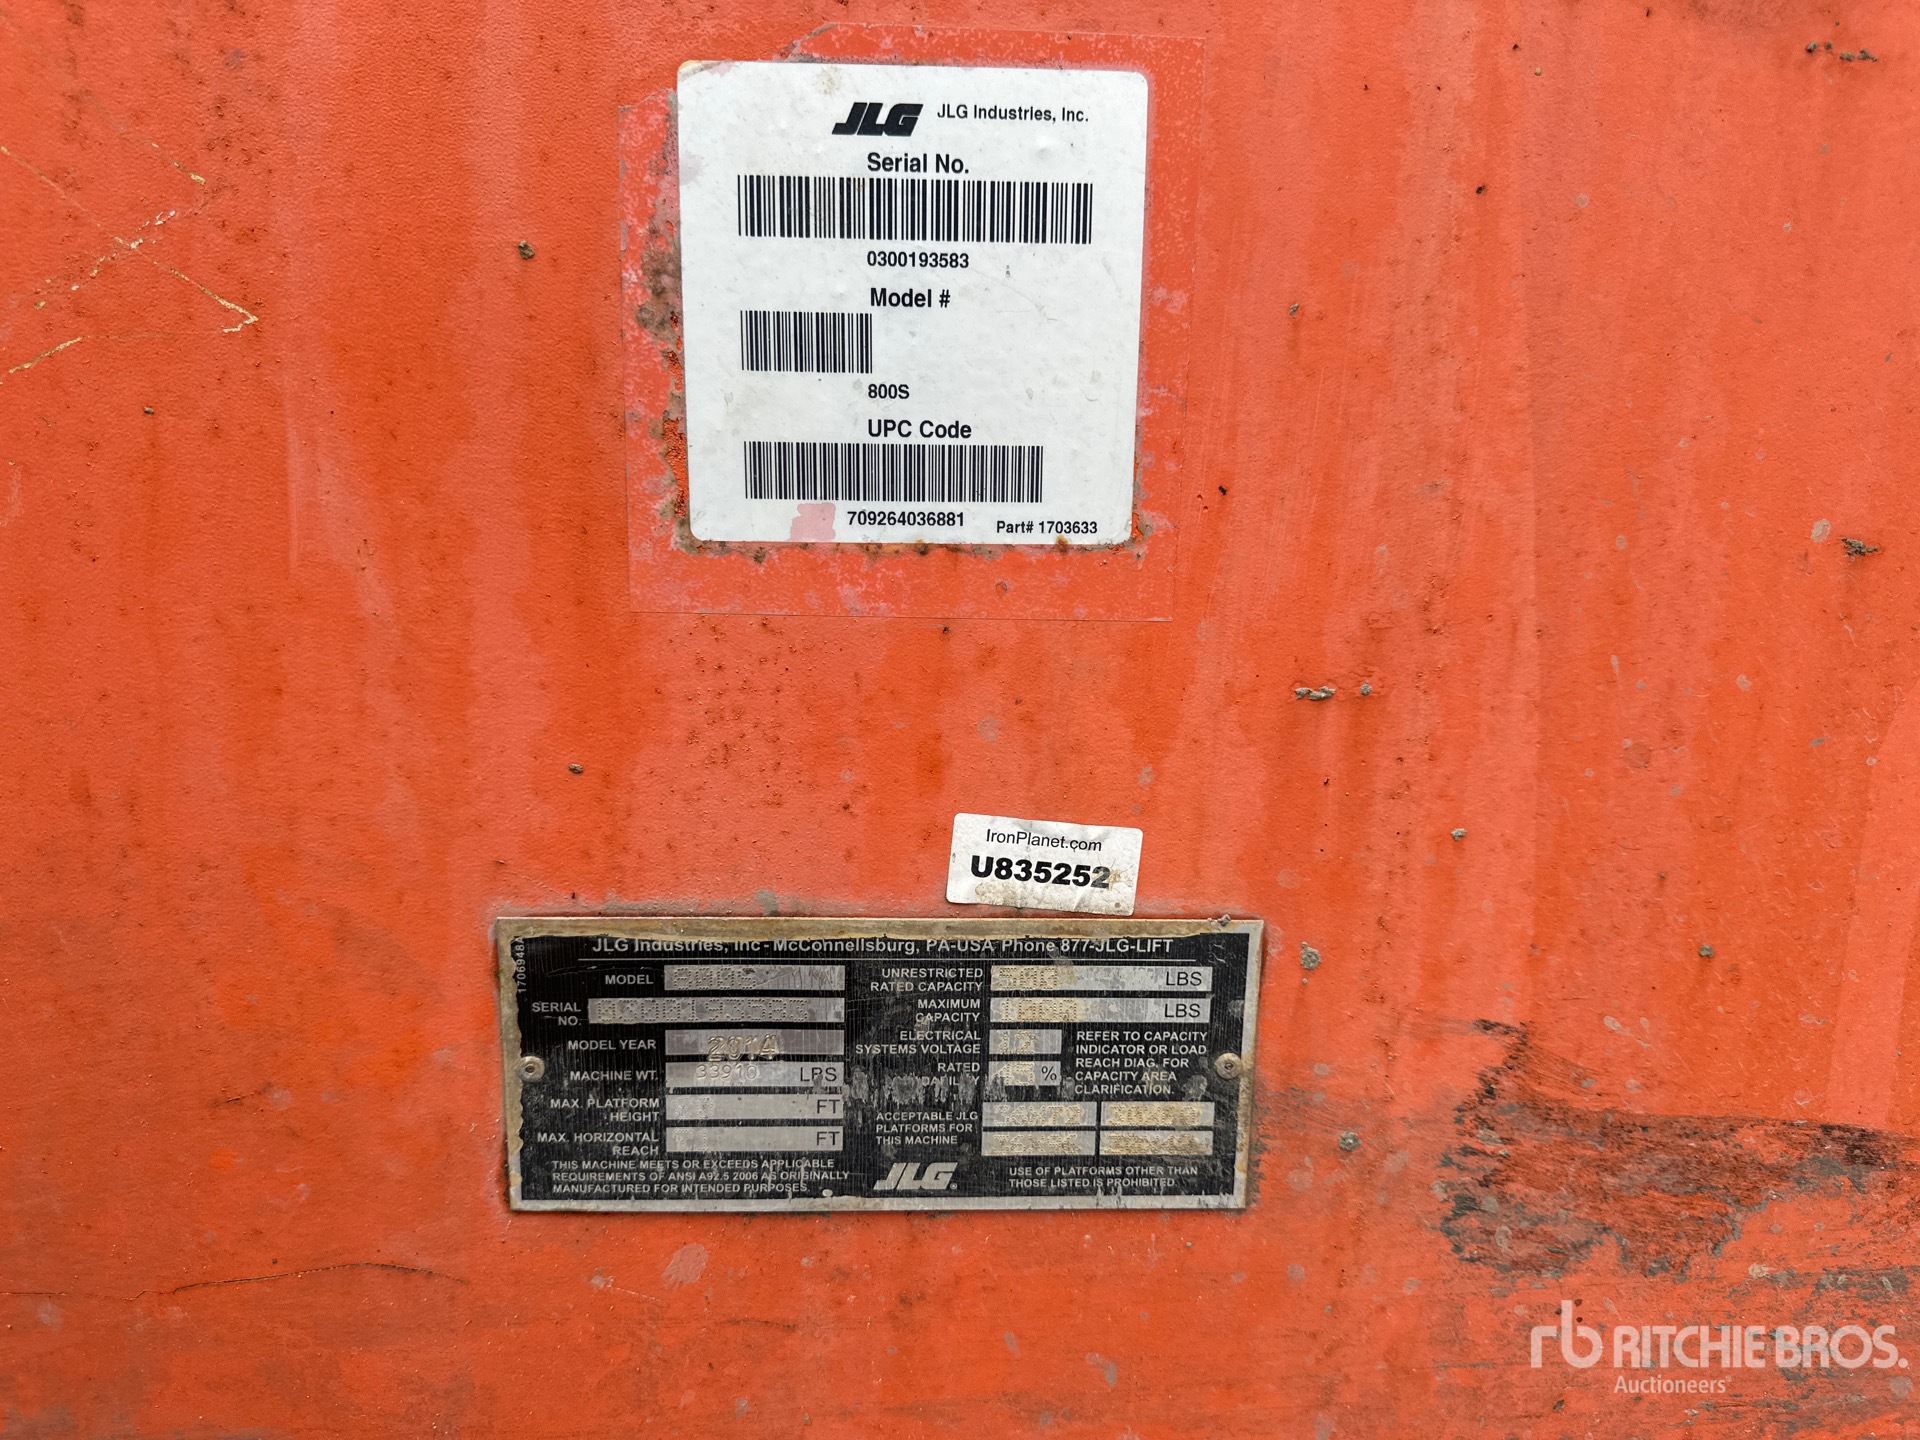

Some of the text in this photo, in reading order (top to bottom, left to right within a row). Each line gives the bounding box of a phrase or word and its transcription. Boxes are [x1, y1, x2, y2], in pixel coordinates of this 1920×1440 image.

[937, 104, 1089, 122] JLG Industries, Inc.
[831, 102, 924, 137] JLG
[867, 152, 969, 174] Serial No.
[867, 251, 969, 269] 0300193583
[870, 288, 951, 308] Model #
[867, 384, 910, 400] 800S
[867, 419, 972, 439] UPC Code
[847, 512, 965, 528] 709264036881
[996, 520, 1098, 535] Part# 1703633
[986, 828, 1102, 852] IronPlanet.com
[971, 855, 1110, 889] U835252
[592, 938, 629, 952] JLG
[634, 939, 728, 954] Industries,
[926, 940, 995, 952] PA-USA
[1002, 939, 1055, 952] Phone
[1061, 939, 1174, 952] 877-JLG-LIFT
[881, 968, 983, 979] UNRESTRICTED
[1165, 972, 1202, 986] LBS
[605, 974, 653, 985] MODEL
[870, 982, 983, 992] RATED CAPACITY
[532, 1002, 582, 1013] SERIAL
[917, 999, 981, 1009] MAXIMUM
[1164, 1003, 1201, 1018] LBS
[558, 1016, 582, 1026] NO.
[915, 1012, 980, 1023] CAPACITY
[900, 1030, 981, 1041] ELECTRICAL
[1077, 1031, 1208, 1041] REFER TO CAPACITY
[568, 1039, 656, 1050] MODEL YEAR
[708, 1034, 781, 1062] 2014
[856, 1044, 981, 1055] SYSTEMS VOLTAGE
[1076, 1044, 1207, 1054] INDICATOR OR LOAD
[938, 1062, 980, 1073] RATED
[1076, 1058, 1189, 1068] REACH DIAG. FOR
[570, 1070, 659, 1081] MACHINE WT.
[695, 1064, 760, 1081] 33910
[1041, 1066, 1057, 1081] %
[1075, 1071, 1177, 1081] CAPACITY AREA
[1075, 1084, 1174, 1095] CLARIFICATION.
[550, 1098, 660, 1109] MAX. PLATFORM
[816, 1100, 841, 1114] FT
[610, 1112, 660, 1122] HEIGHT
[876, 1111, 978, 1121] ACCEPTABLE JLG
[876, 1123, 972, 1133] PLATFORMS FOR
[537, 1132, 660, 1143] MAX. HORIZONTAL
[816, 1132, 841, 1145] FT
[876, 1136, 958, 1145] THIS MACHINE
[612, 1146, 660, 1156] REACH
[552, 1159, 835, 1169] THIS MACHINE MEETS OR EXCEEDS APPLICABLE
[553, 1171, 849, 1182] REQUIREMENTS OF ANSI A92.5 2006 AS ORIGINALLY
[873, 1162, 958, 1190] JLG
[1009, 1166, 1198, 1176] USE OF PLATFORMS OTHER THAN
[553, 1183, 811, 1193] MANUFACTURED FOR INTENDED PURPOSES.
[1009, 1178, 1047, 1188] THOSE
[1051, 1178, 1090, 1188] LISTED
[1093, 1178, 1103, 1188] IS
